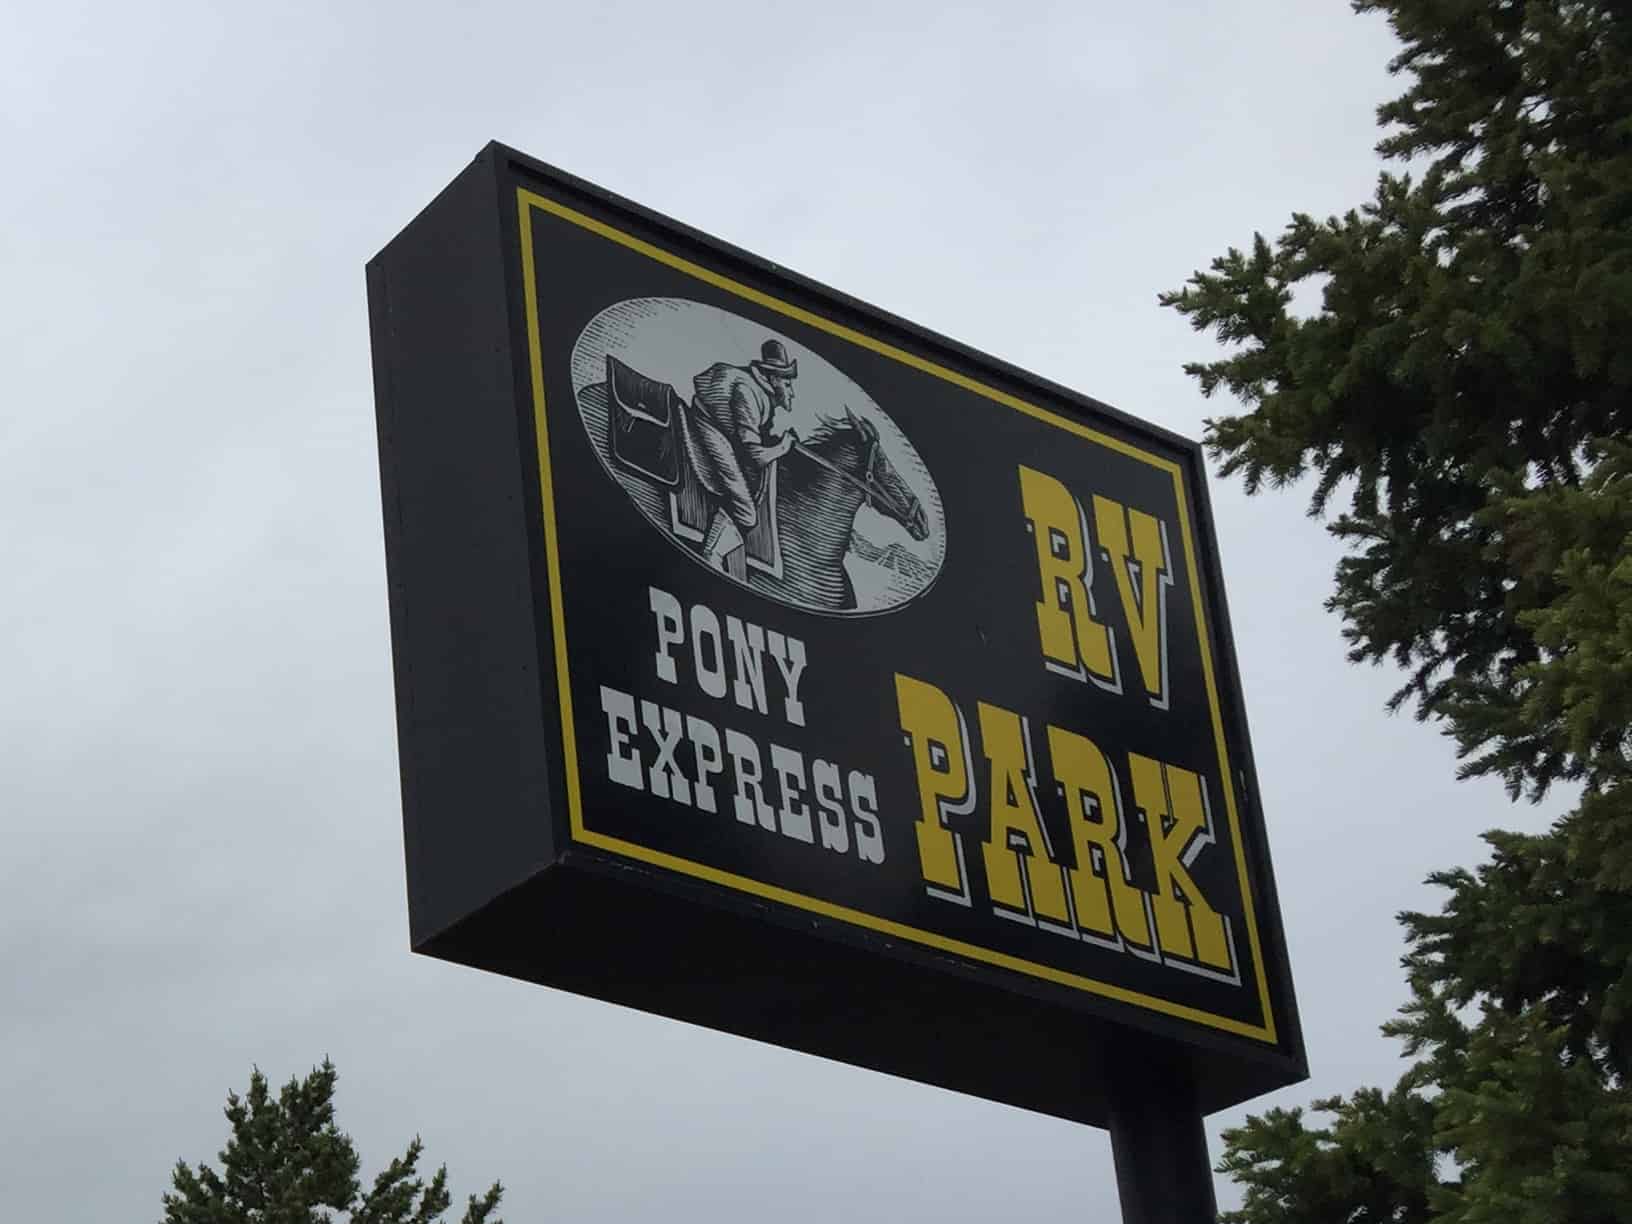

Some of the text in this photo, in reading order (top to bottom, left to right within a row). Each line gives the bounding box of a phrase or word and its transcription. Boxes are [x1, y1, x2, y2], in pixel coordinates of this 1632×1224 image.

[648, 585, 808, 728] PONY
[1018, 464, 1174, 711] RV
[599, 684, 886, 866] EXPRESS
[894, 671, 1243, 987] PARK
